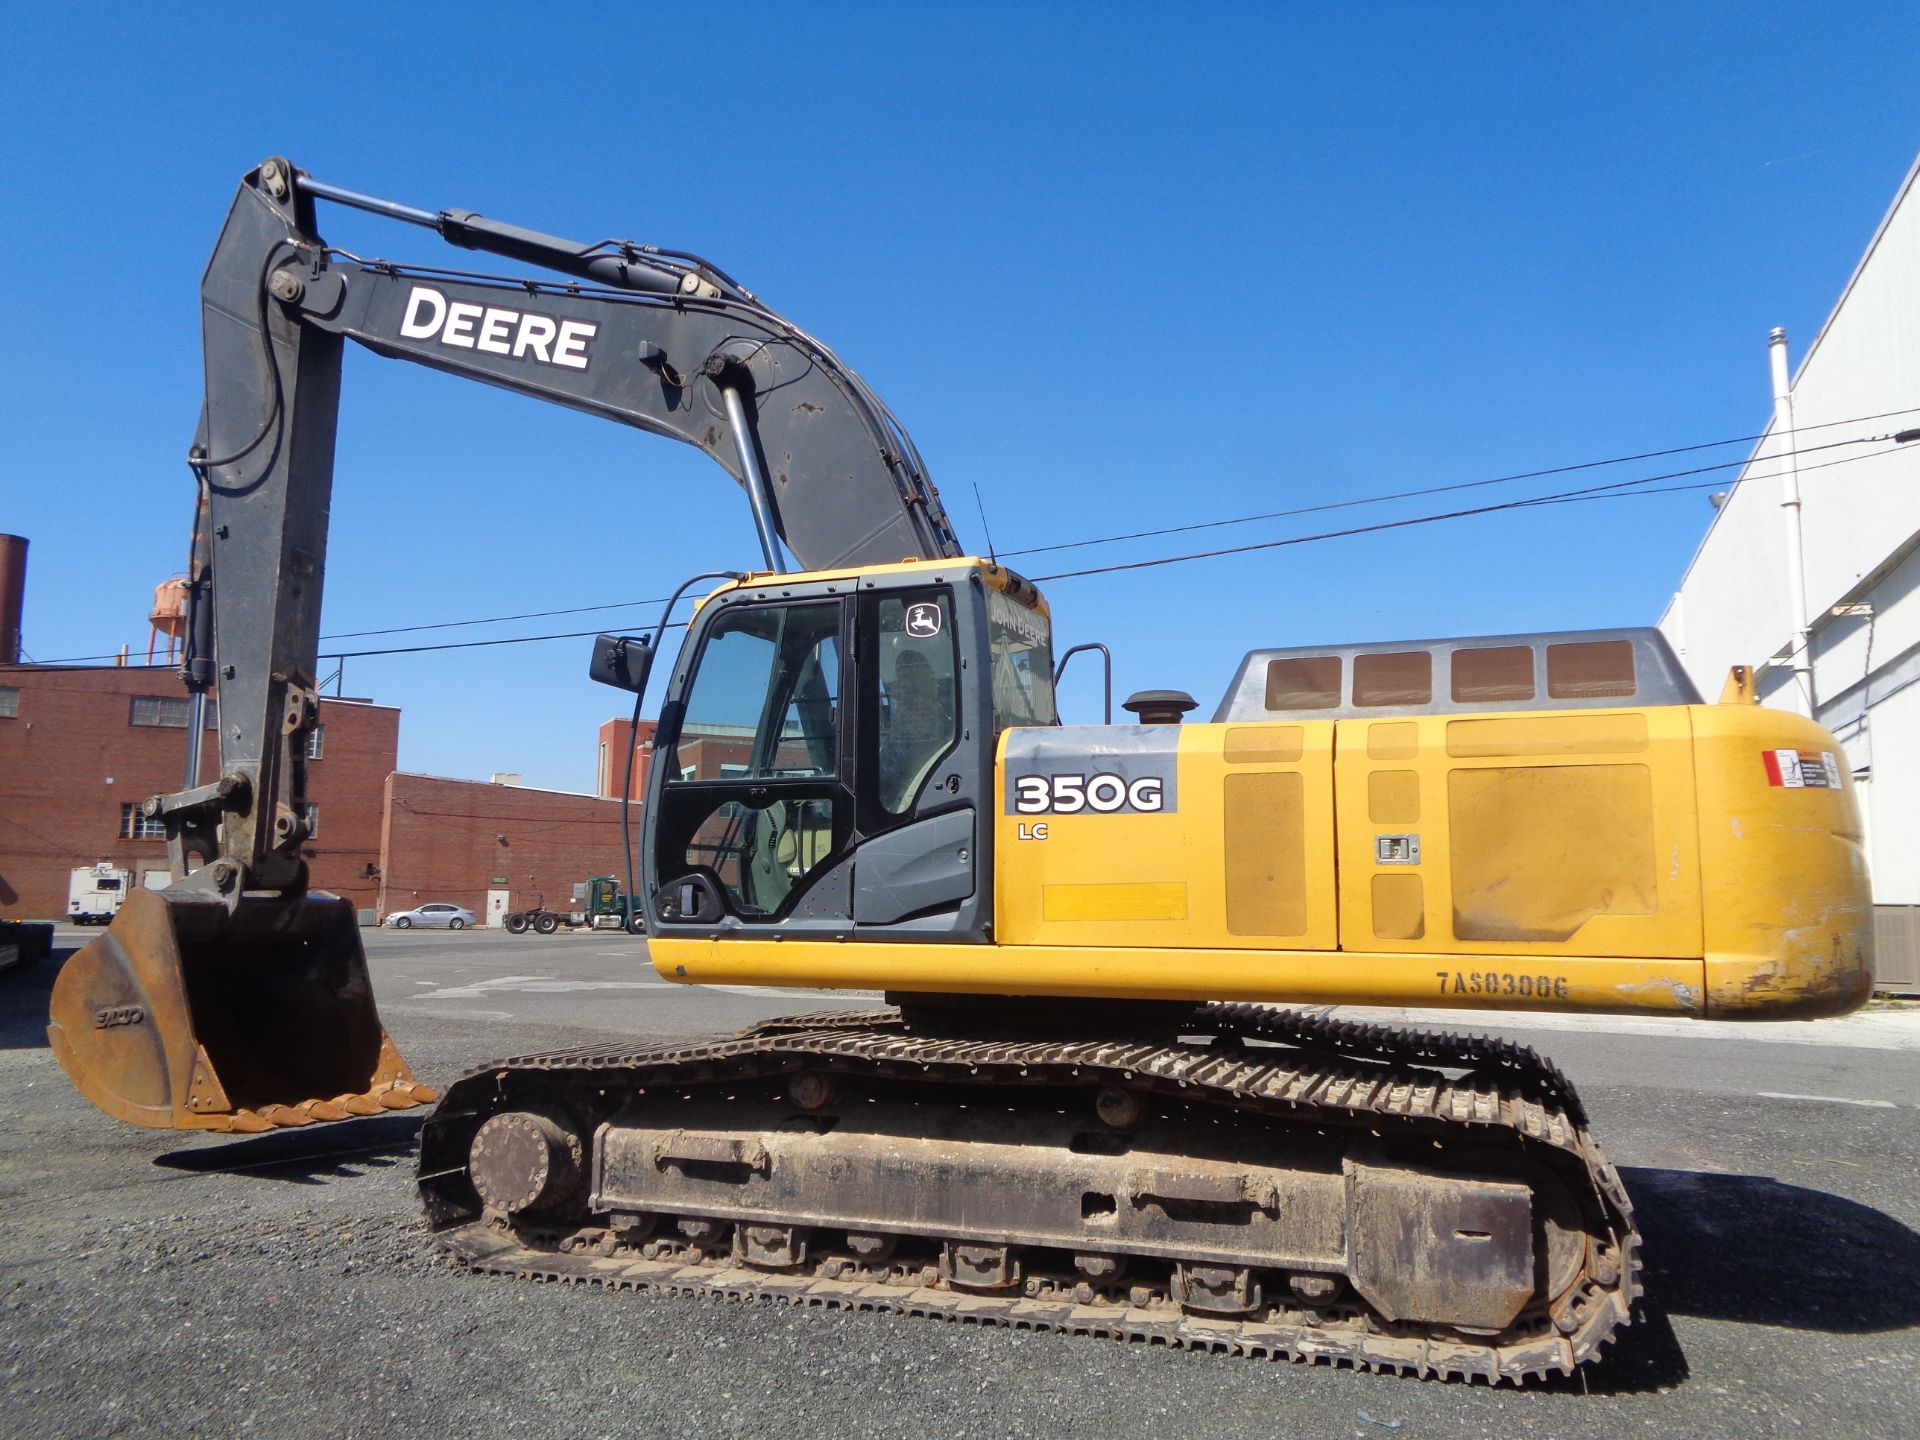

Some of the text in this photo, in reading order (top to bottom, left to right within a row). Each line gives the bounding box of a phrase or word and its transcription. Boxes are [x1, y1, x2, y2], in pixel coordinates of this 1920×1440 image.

[401, 286, 596, 369] DEERE
[991, 604, 1047, 647] JOHN DEERE
[1016, 772, 1163, 814] 350G
[1018, 823, 1048, 840] LC
